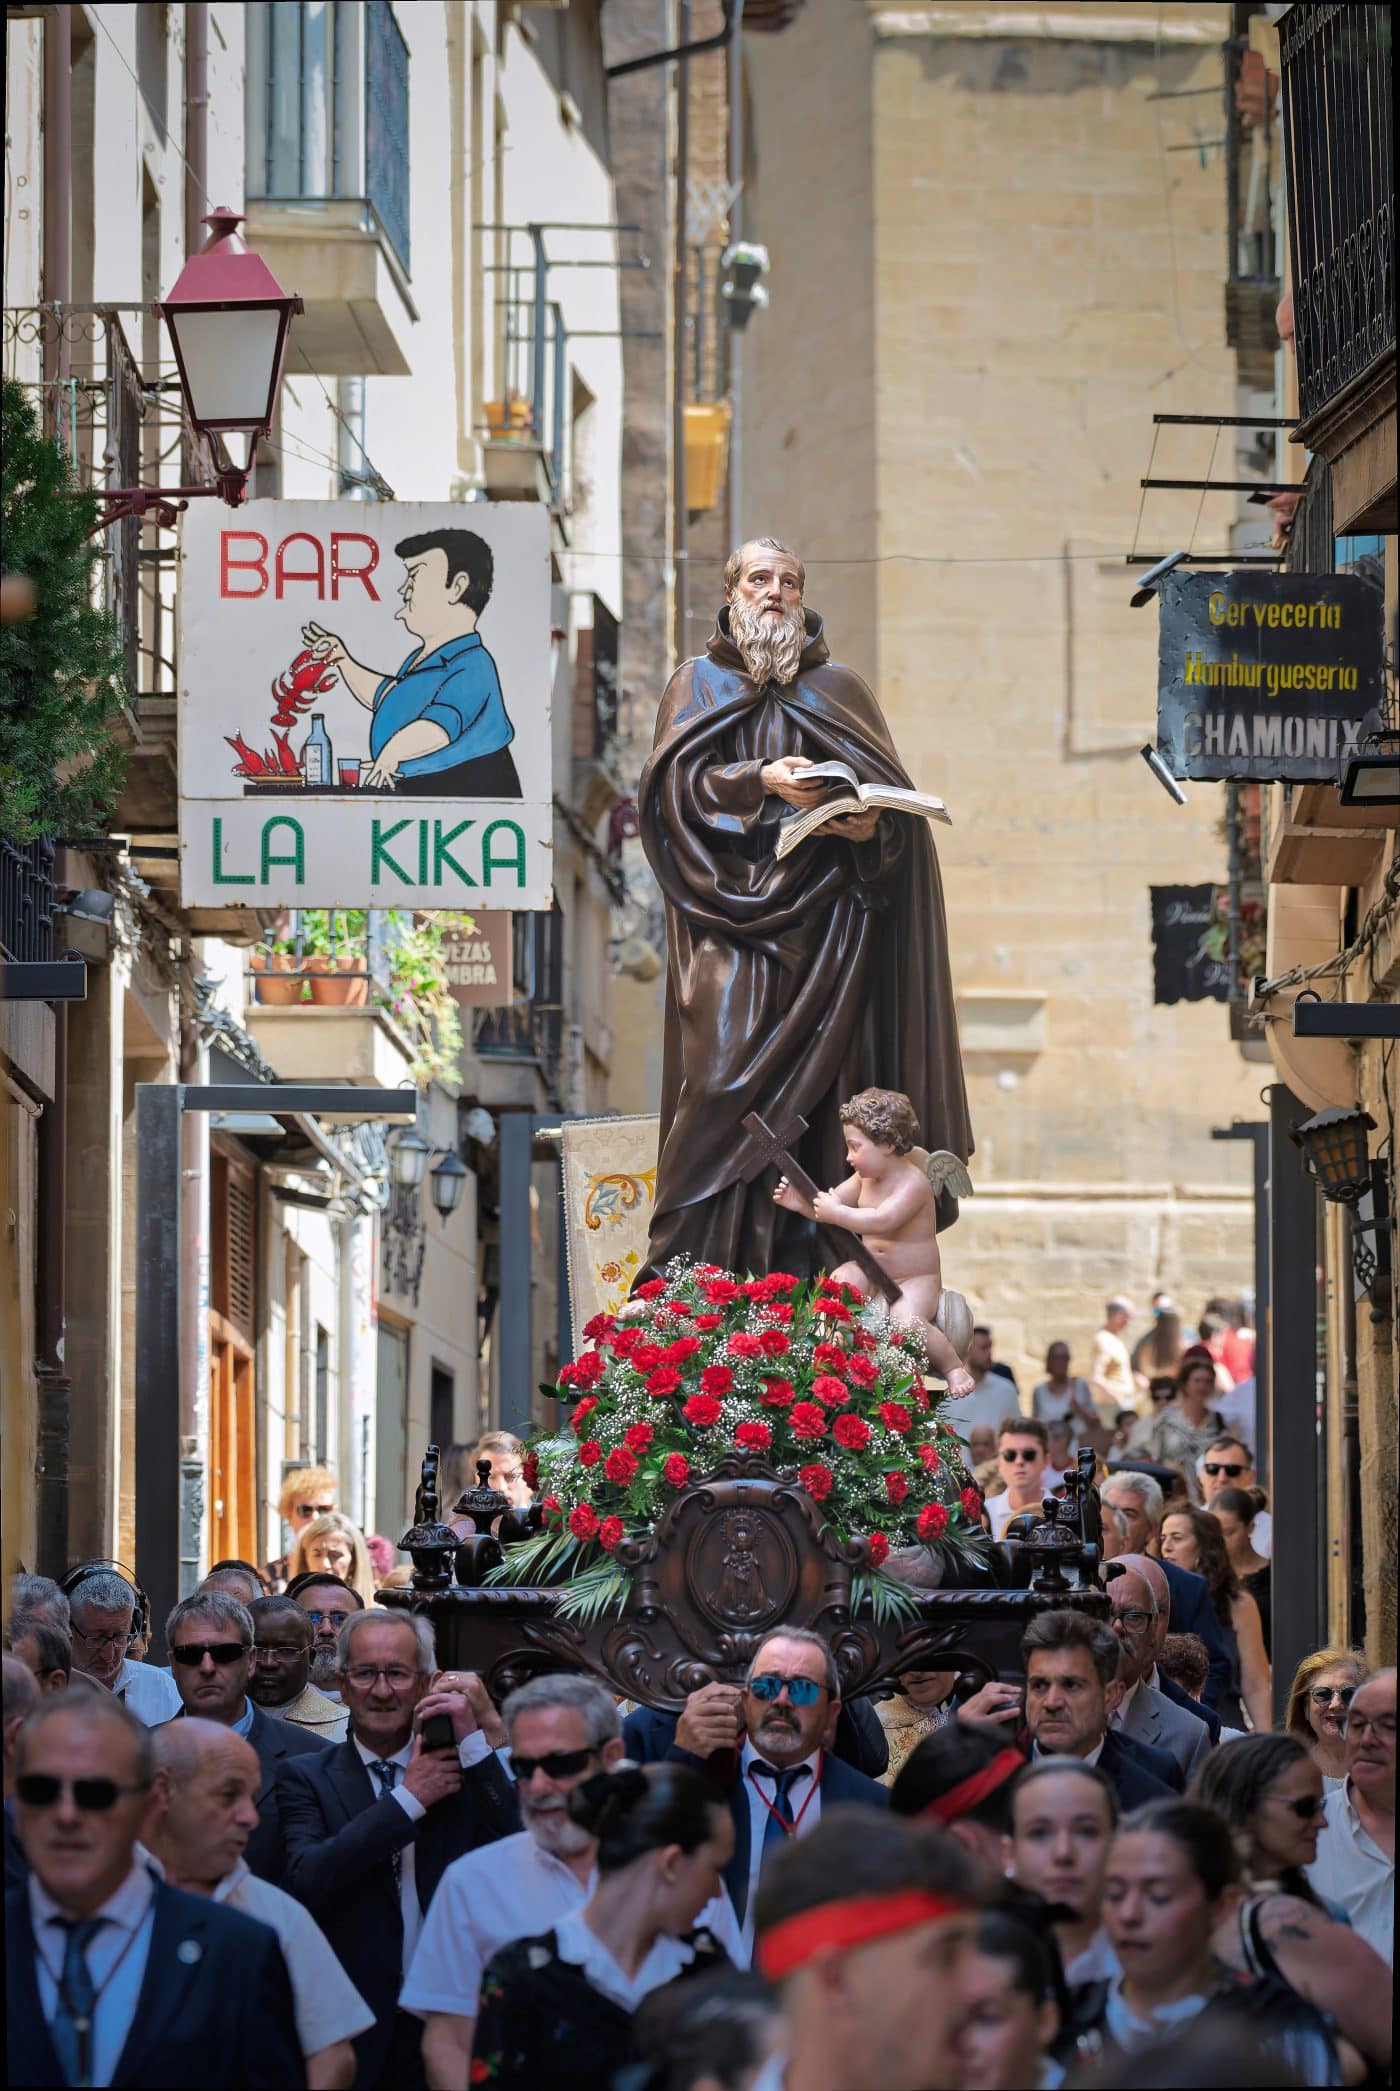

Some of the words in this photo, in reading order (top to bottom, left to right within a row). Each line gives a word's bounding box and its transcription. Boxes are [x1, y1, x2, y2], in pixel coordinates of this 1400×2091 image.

[219, 530, 381, 602] BAR
[1184, 711, 1362, 760] CHAMONIX
[212, 815, 305, 885] LA
[371, 819, 527, 888] KIKA
